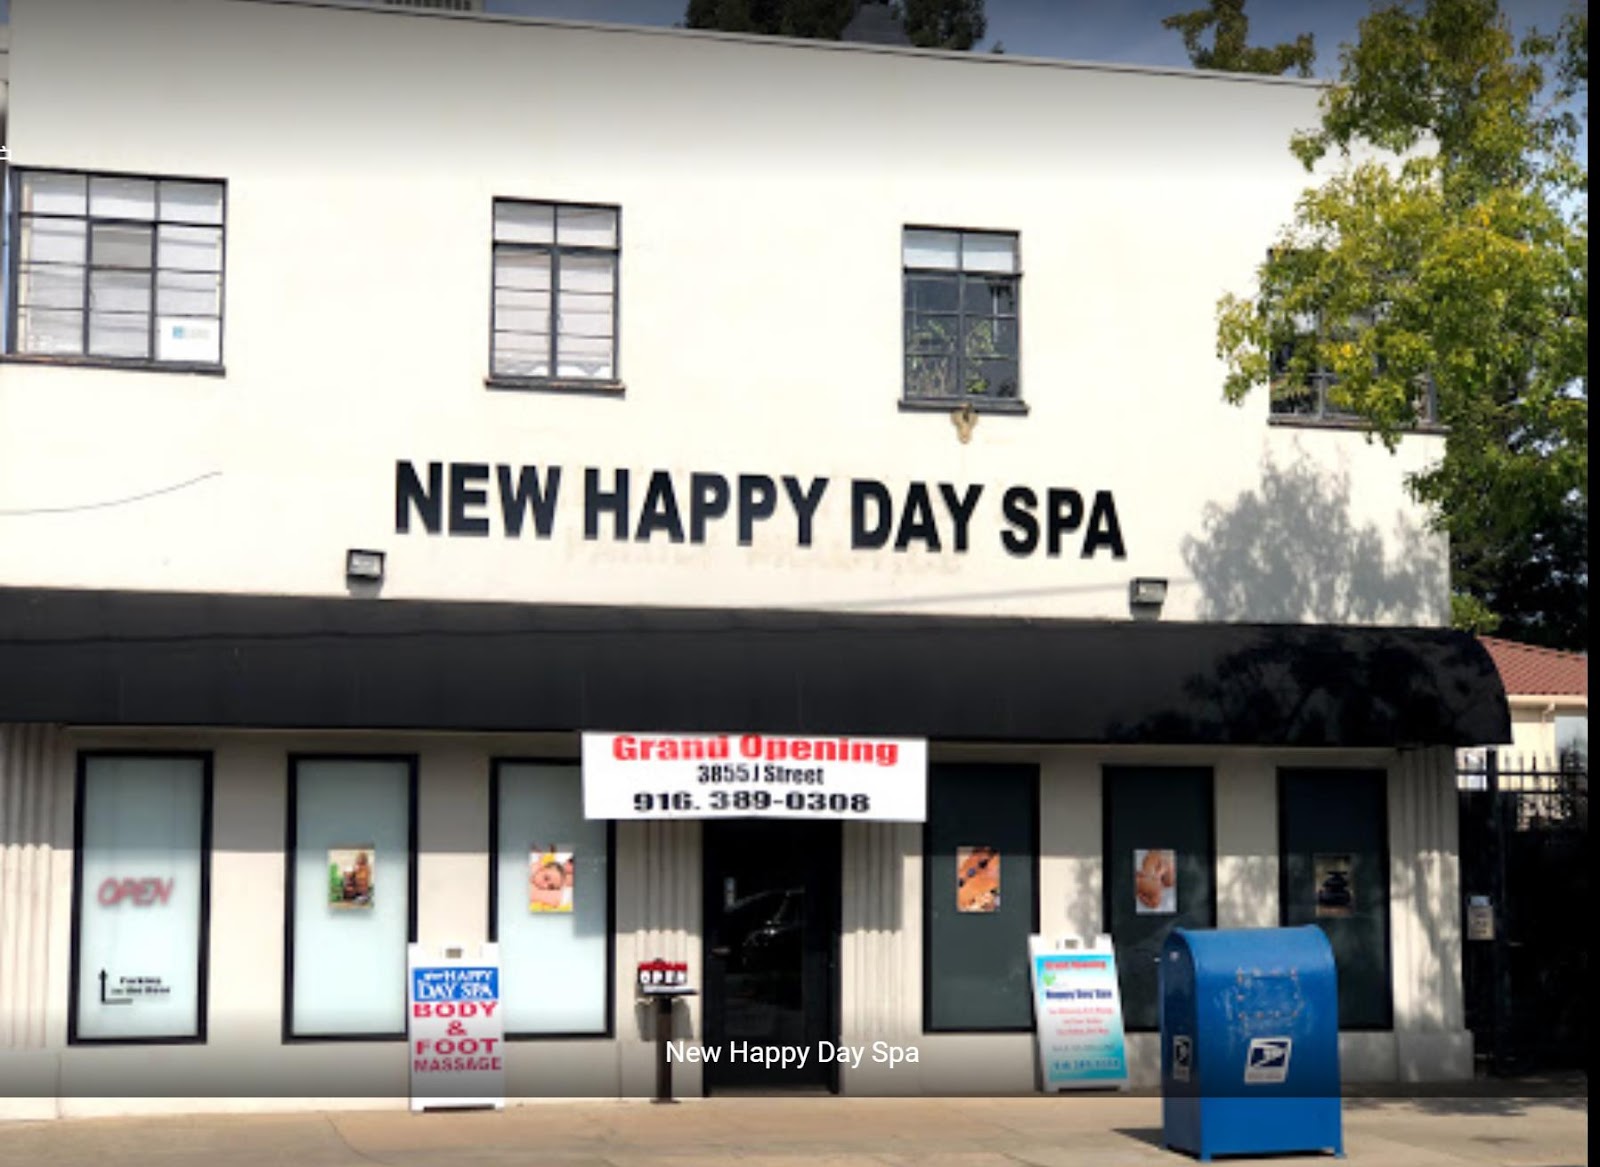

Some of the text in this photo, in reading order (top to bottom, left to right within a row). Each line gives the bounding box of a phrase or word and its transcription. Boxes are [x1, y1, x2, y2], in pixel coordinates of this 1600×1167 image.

[396, 460, 1127, 560] NEW HAPPY DAY SPA
[612, 734, 900, 767] Grand Opening
[697, 764, 750, 785] 3855
[763, 765, 825, 786] Street
[633, 790, 871, 813] 916. 389-0308
[97, 876, 174, 908] OPEN
[417, 980, 493, 999] DAY SPA
[413, 1001, 498, 1018] BODY
[446, 1020, 468, 1036] &
[415, 1037, 499, 1055] FOOT
[413, 1056, 502, 1072] MASSAGE
